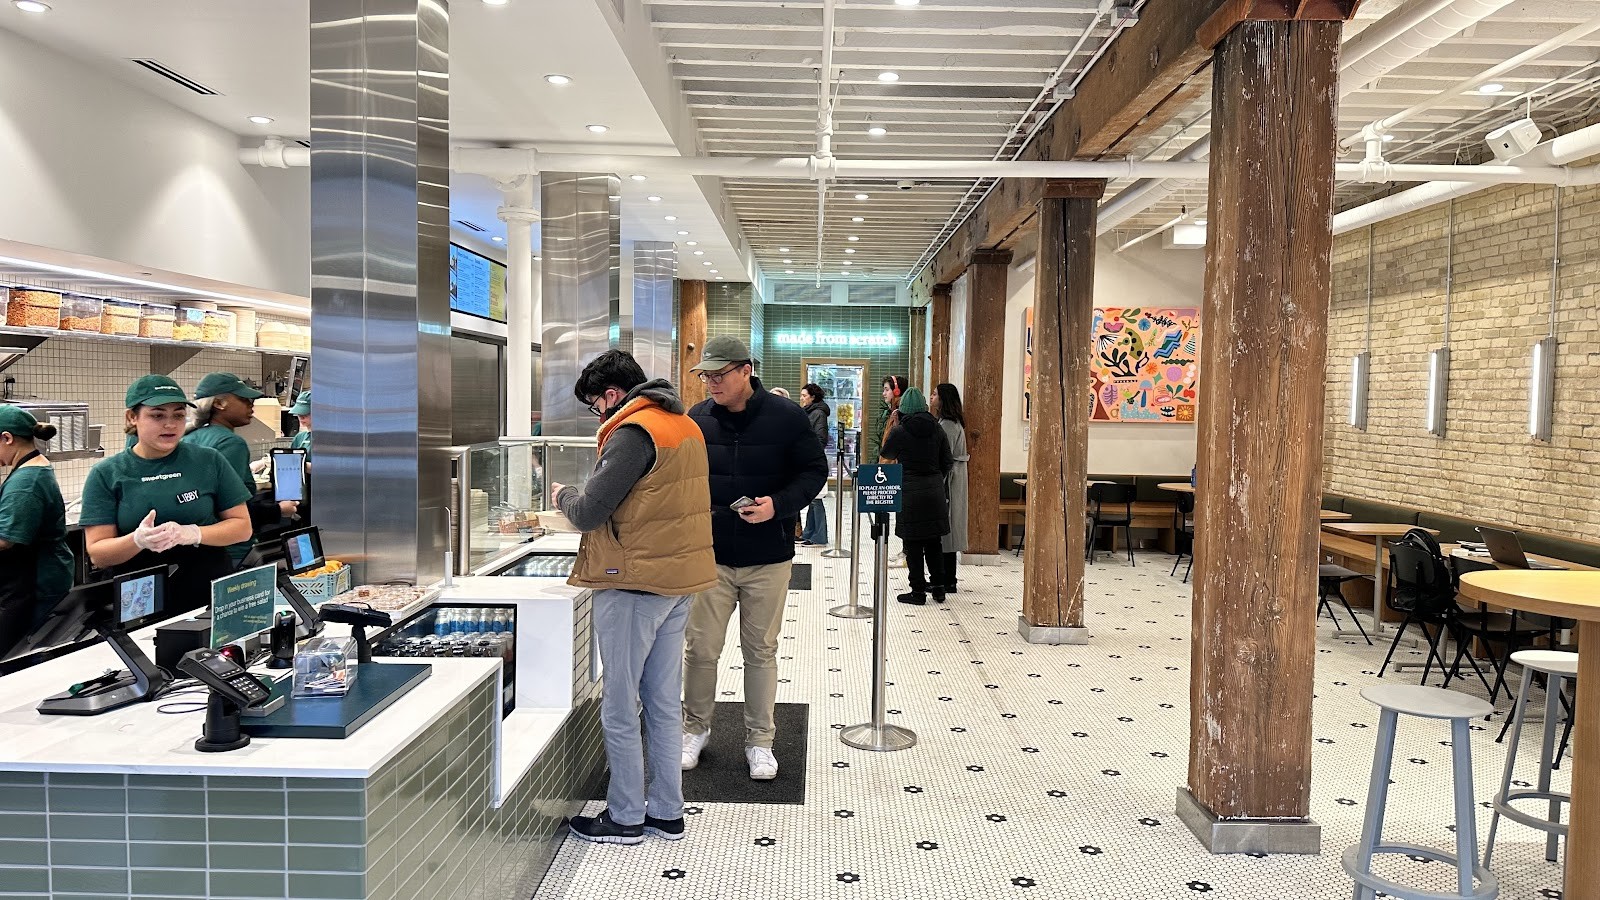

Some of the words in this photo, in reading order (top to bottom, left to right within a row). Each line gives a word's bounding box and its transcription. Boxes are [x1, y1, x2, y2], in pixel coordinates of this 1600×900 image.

[777, 331, 813, 344] made
[815, 331, 848, 345] from
[849, 331, 896, 346] scratch
[141, 472, 182, 482] sweetgreen
[176, 490, 199, 504] LIBBY
[227, 584, 240, 593] Weekly
[241, 580, 257, 590] drawing
[228, 600, 237, 609] your
[237, 595, 254, 605] business
[254, 591, 264, 599] card
[220, 610, 233, 619] chance
[249, 600, 257, 608] free
[257, 597, 269, 605] salad
